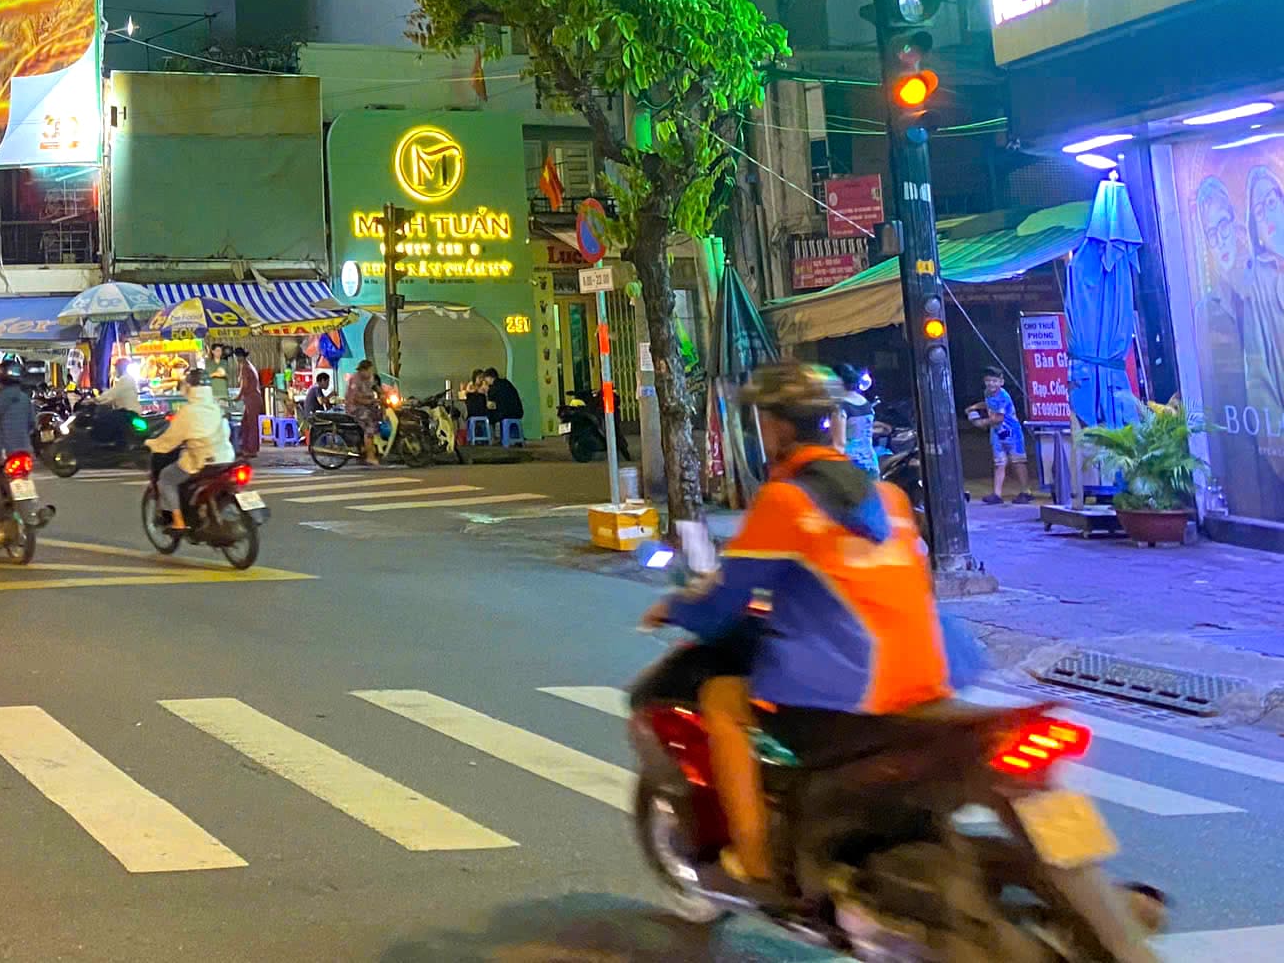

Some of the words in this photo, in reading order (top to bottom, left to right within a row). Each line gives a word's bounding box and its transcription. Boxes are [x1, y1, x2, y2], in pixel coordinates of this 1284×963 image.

[353, 212, 427, 237] MH
[430, 206, 511, 238] TUẤN
[205, 308, 239, 325] be
[1034, 352, 1054, 368] Bàn
[1224, 404, 1284, 438] BOL
